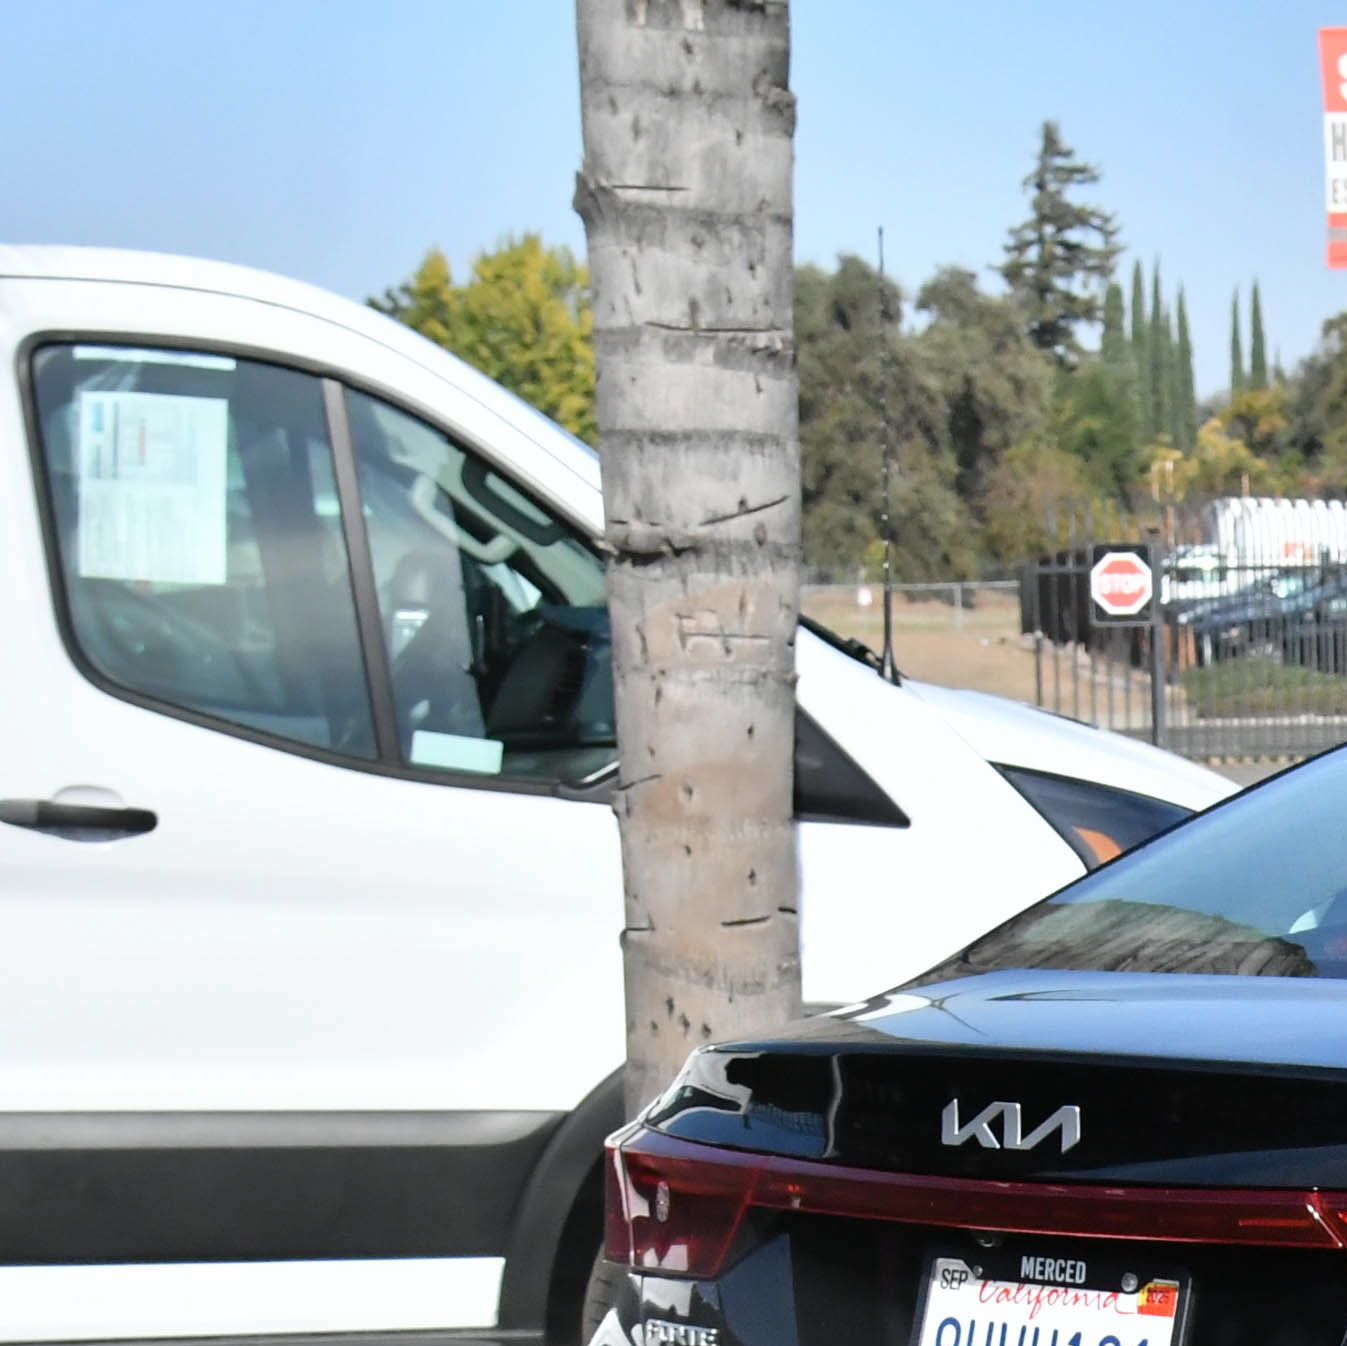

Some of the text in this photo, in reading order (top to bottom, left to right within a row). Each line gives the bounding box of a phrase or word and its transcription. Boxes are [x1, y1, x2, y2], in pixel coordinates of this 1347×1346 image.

[1098, 572, 1145, 595] STOP
[940, 1098, 1082, 1154] KIA
[939, 1268, 969, 1291] SEP
[1020, 1255, 1087, 1284] MERCED
[977, 1279, 1136, 1320] California
